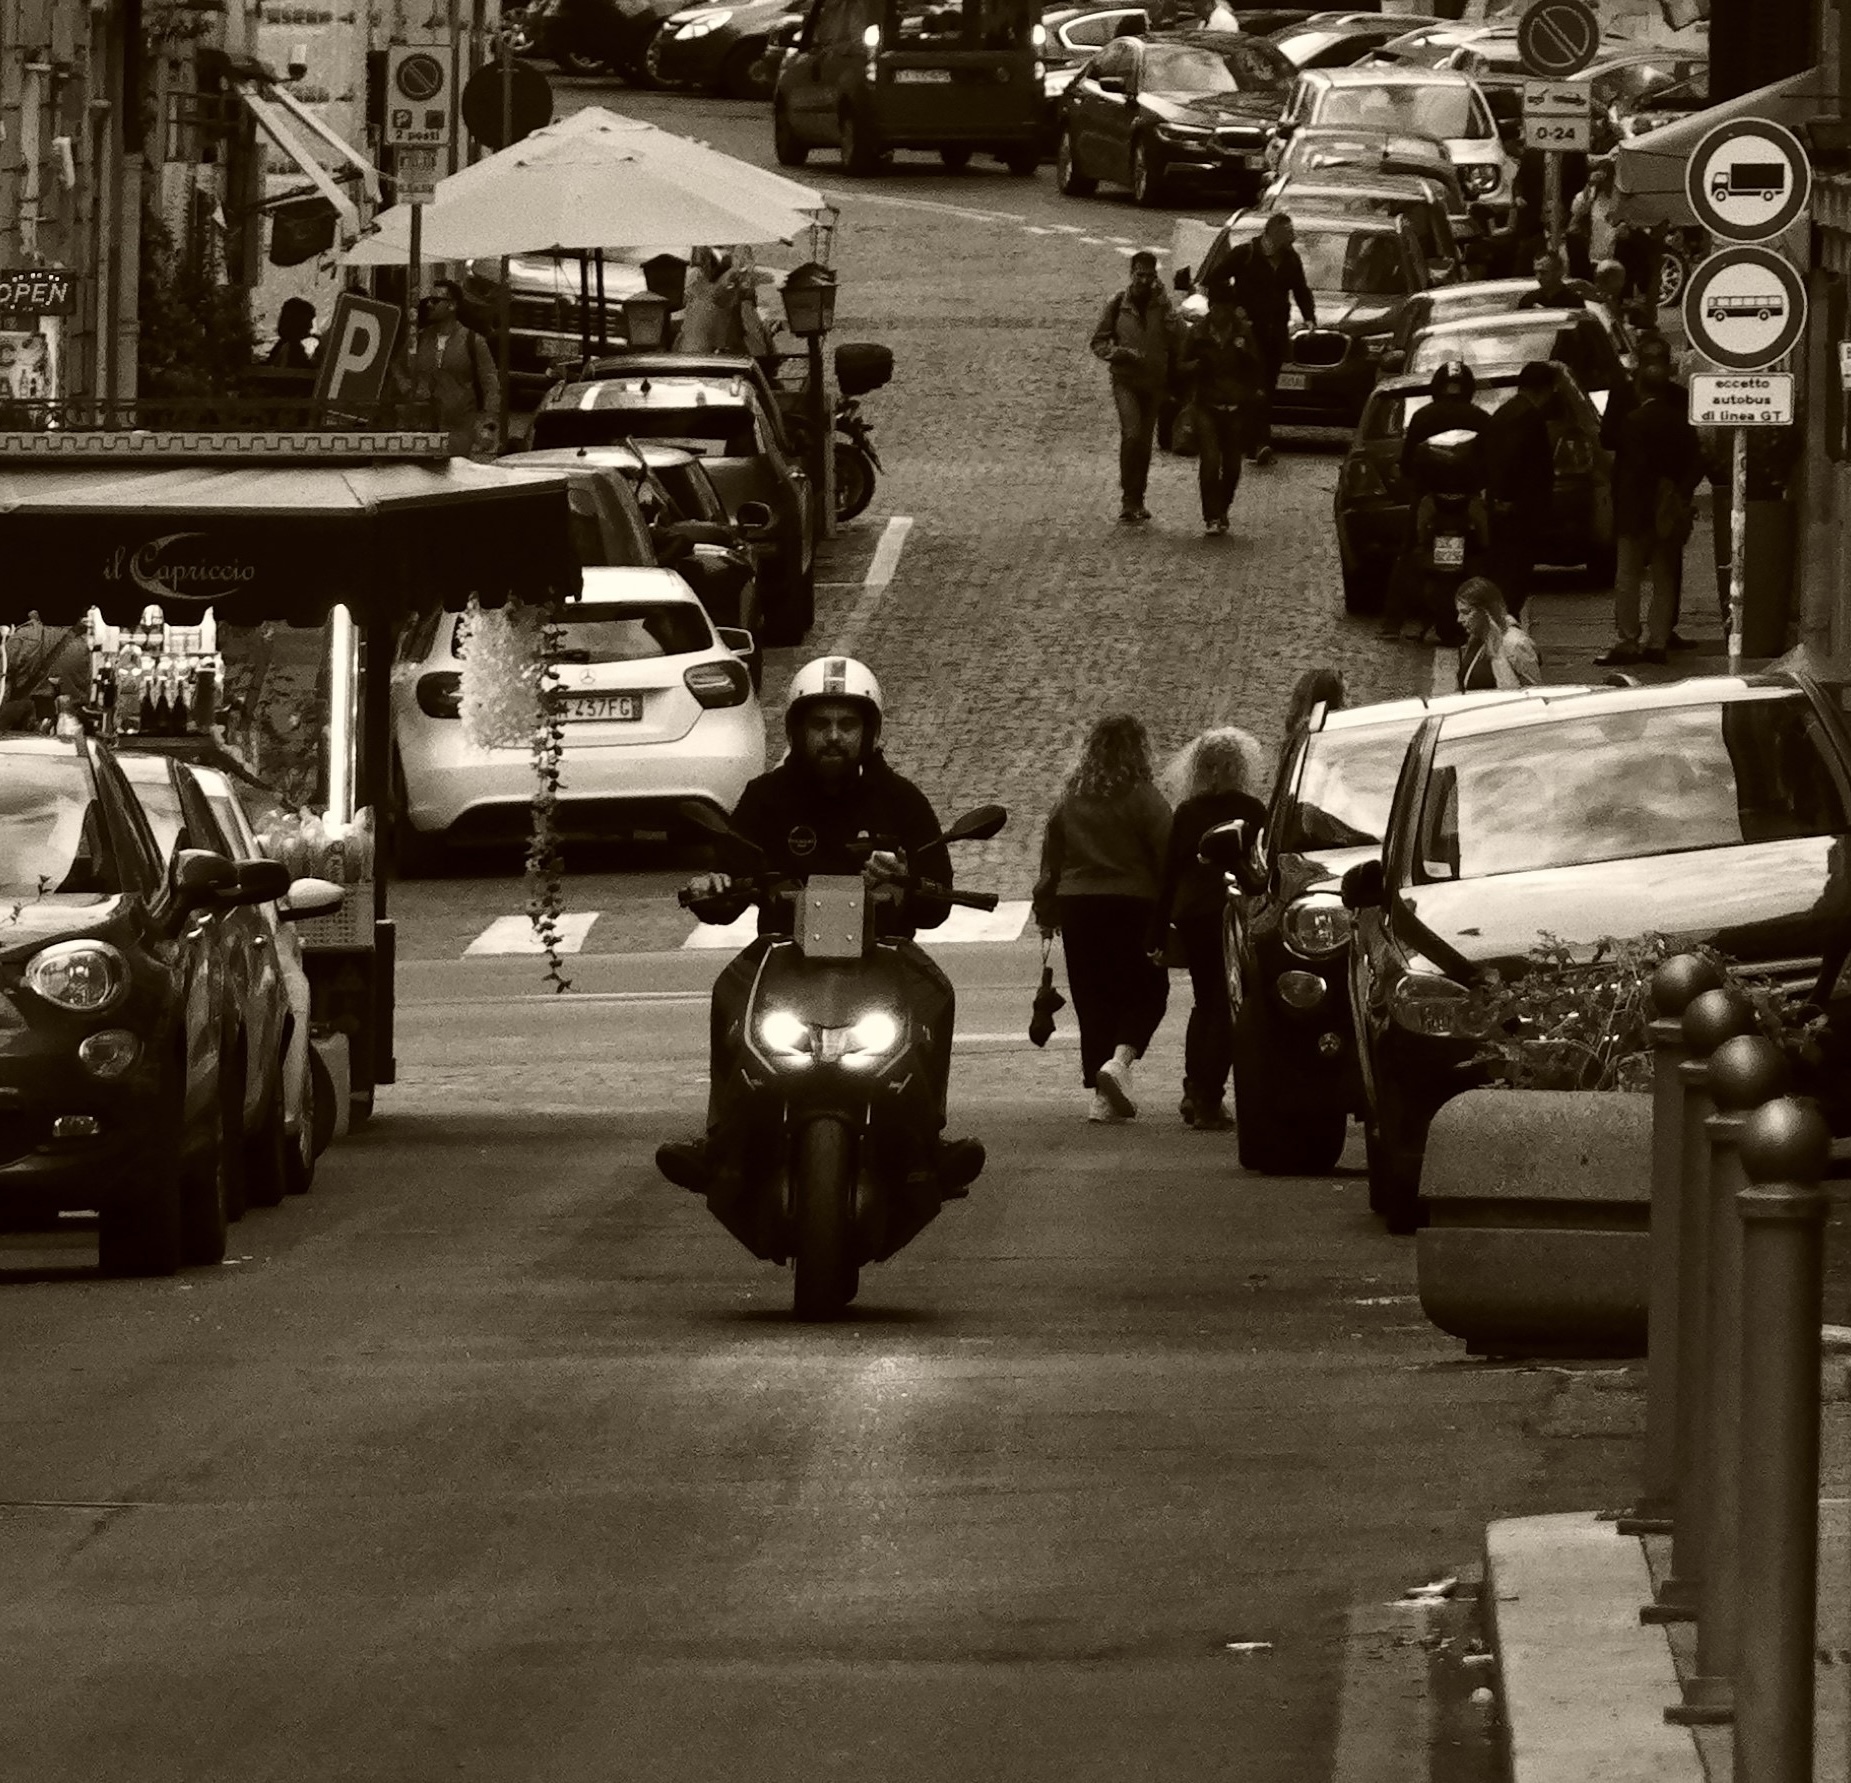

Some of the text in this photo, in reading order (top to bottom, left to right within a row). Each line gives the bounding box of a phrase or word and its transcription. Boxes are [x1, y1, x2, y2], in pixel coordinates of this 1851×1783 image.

[396, 129, 440, 141] 2 posti
[1536, 127, 1575, 139] 0-24
[0, 282, 68, 303] OPEN
[327, 308, 380, 400] P
[1715, 378, 1770, 389] eccetto
[1712, 394, 1771, 405] autobus
[1701, 410, 1783, 421] di linea GT
[103, 541, 255, 592] il Capriccio
